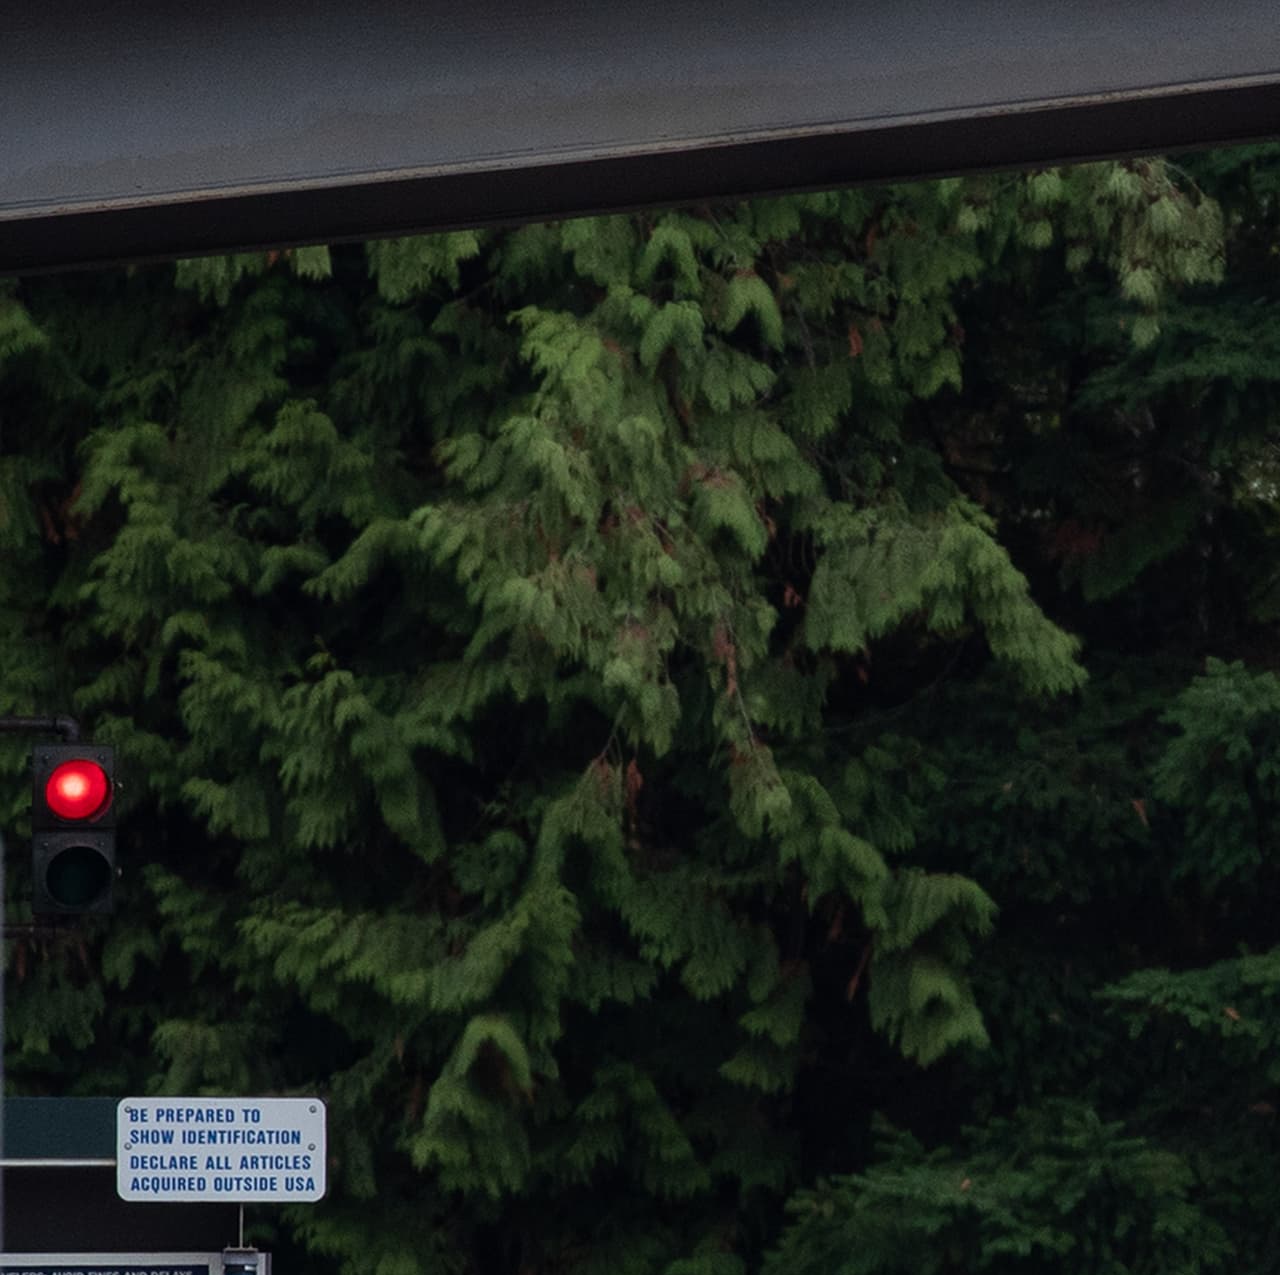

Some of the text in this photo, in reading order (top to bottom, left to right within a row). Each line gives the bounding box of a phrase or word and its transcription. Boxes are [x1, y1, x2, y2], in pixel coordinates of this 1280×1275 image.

[130, 1108, 261, 1122] BE PREPARED TO
[130, 1130, 301, 1144] SHOW IDENTIFICATION
[130, 1155, 312, 1170] DECLARE ALL ARTICLES
[131, 1177, 315, 1193] ACQUIRED OUTSIDE USA
